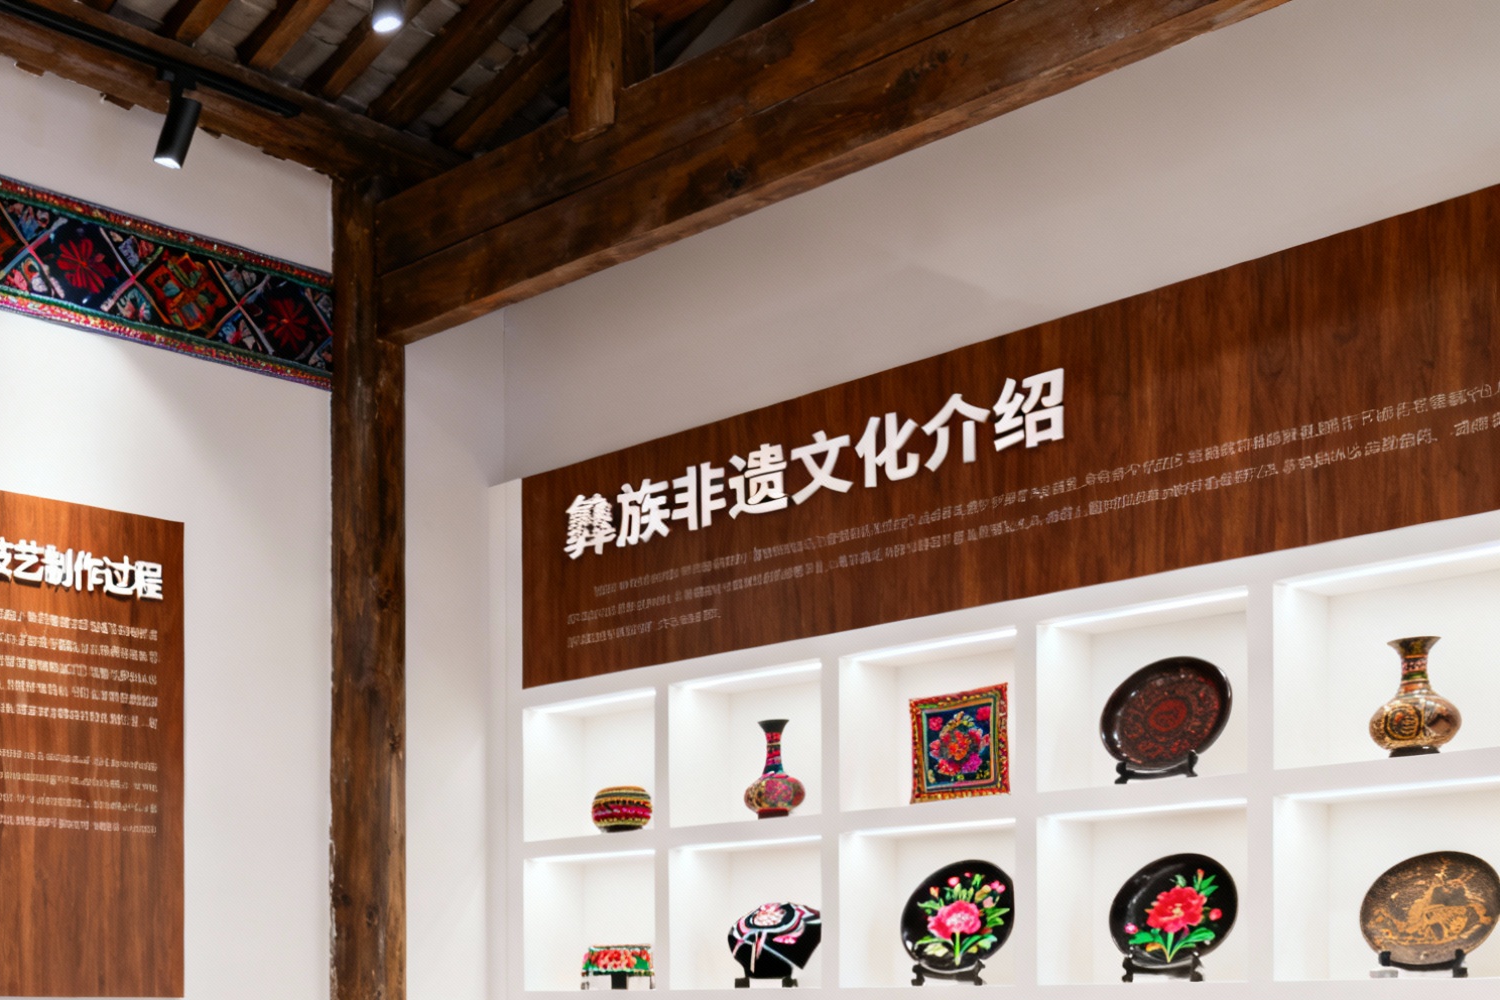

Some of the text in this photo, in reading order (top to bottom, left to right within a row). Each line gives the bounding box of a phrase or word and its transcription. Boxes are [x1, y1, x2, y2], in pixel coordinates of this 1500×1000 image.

[564, 368, 1064, 560] 彝族非遗文化介绍
